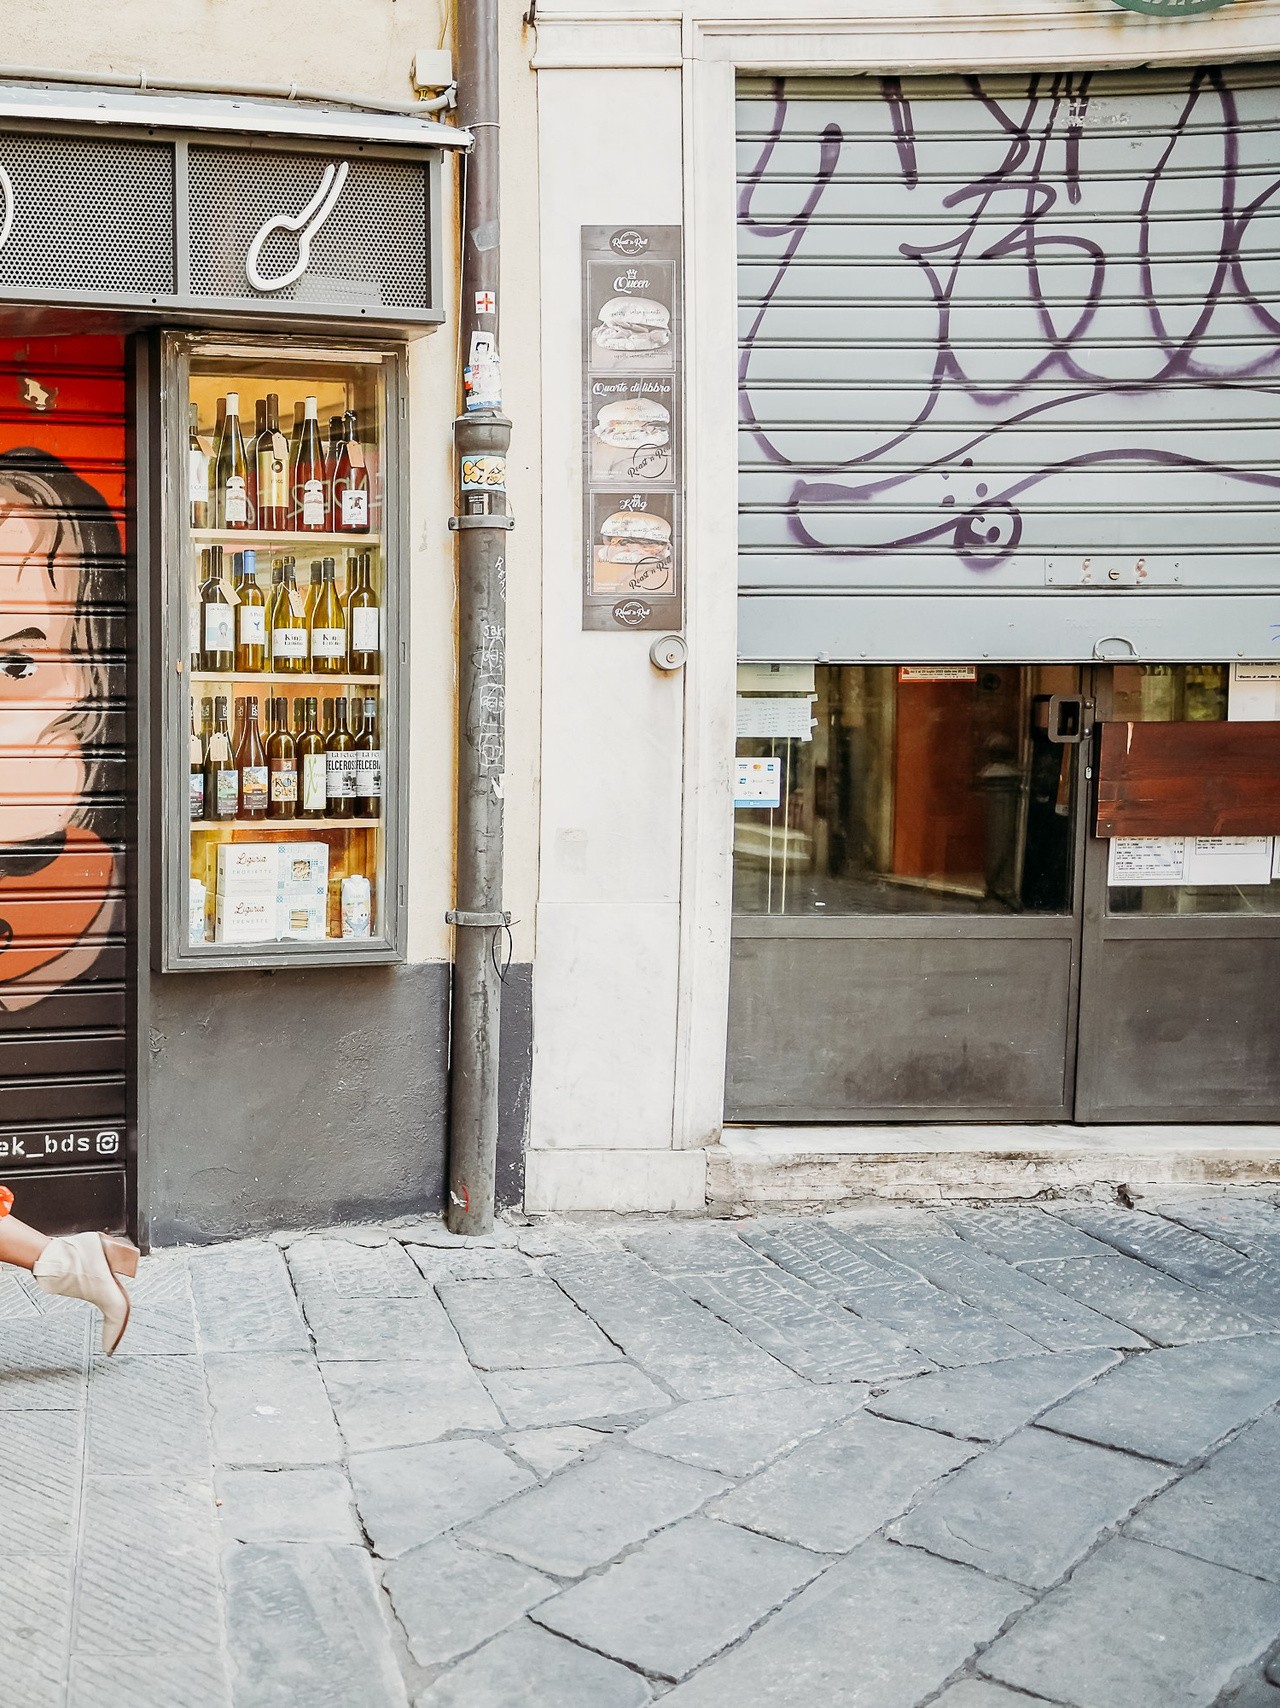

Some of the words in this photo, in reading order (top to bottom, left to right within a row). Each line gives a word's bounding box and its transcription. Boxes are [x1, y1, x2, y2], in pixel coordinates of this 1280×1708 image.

[613, 276, 650, 294] Queen
[592, 382, 628, 397] Quarto
[630, 382, 640, 392] di
[642, 382, 671, 393] libbra
[619, 498, 648, 512] King
[236, 852, 267, 867] Liguria
[233, 901, 265, 916] Liguria
